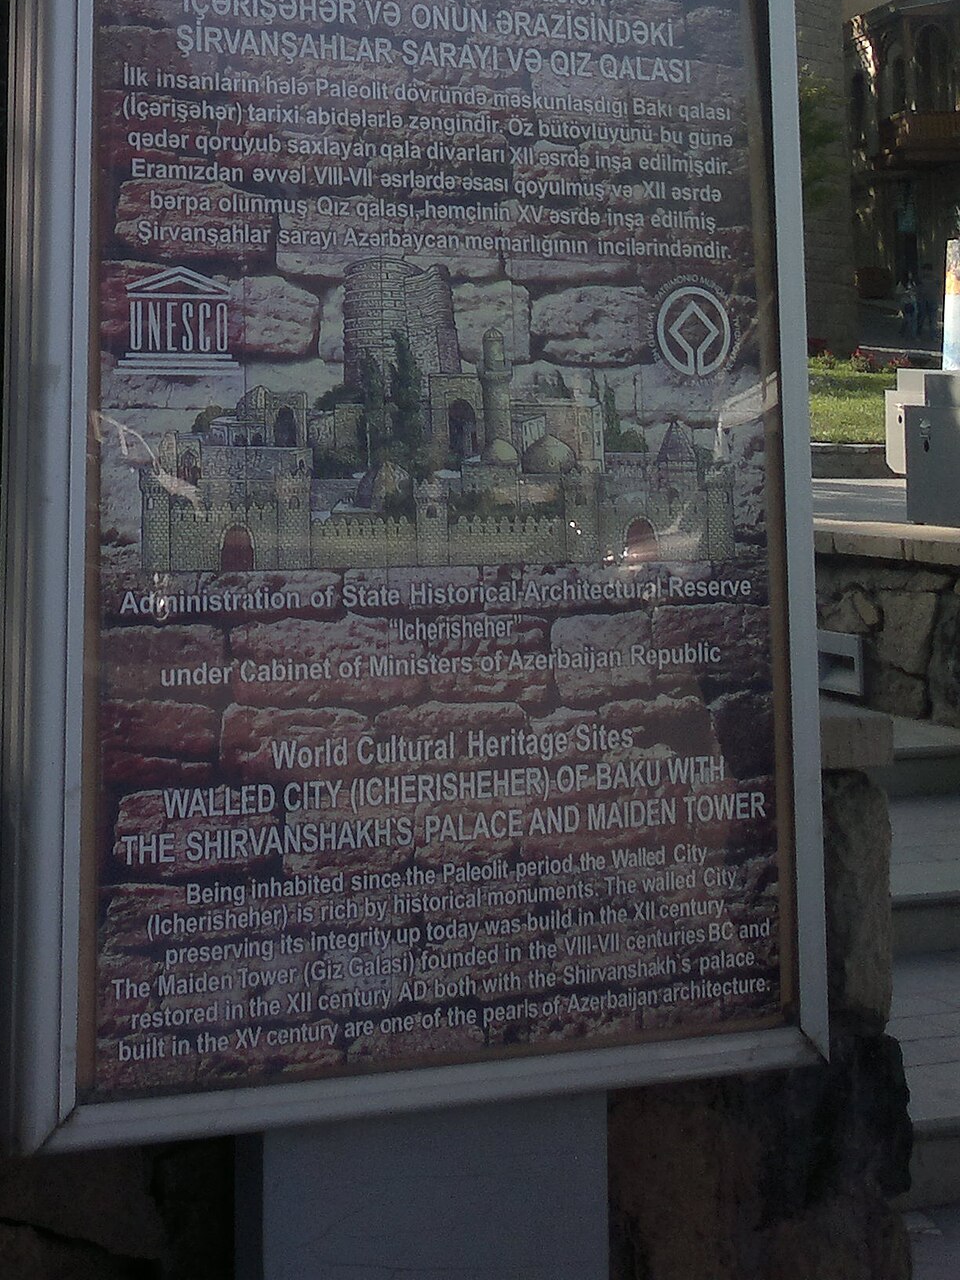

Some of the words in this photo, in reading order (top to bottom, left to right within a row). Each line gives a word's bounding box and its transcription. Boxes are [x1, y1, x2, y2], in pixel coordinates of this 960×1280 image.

[176, 20, 393, 66] ŞİRVANŞAHLAR
[402, 39, 498, 70] SARAYI
[506, 49, 541, 73] VƏ
[550, 50, 592, 77] QIZ
[599, 53, 691, 83] QALASI
[364, 0, 401, 27] VƏ
[411, 3, 487, 33] ONUN
[495, 10, 674, 48] ƏRAZİSİNDƏKİ
[122, 93, 241, 125] (İçərişəhər)
[248, 104, 299, 122] tarixi
[306, 105, 402, 129] abidələrlə
[409, 114, 504, 136] zəngindir.
[508, 114, 534, 137] Öz
[539, 119, 653, 144] bütövlüyünü
[660, 127, 683, 144] bu
[689, 127, 733, 149] günə
[123, 62, 148, 87] İlk
[156, 68, 259, 93] insanların
[265, 76, 308, 96] hələ
[315, 78, 389, 100] Paleolit
[394, 83, 487, 106] dövründə
[494, 91, 628, 119] məskunlaşdığı
[633, 98, 672, 117] Bakı
[678, 102, 731, 121] qalası
[138, 220, 271, 246] Şirvanşahlar
[278, 230, 338, 249] sarayı
[344, 227, 460, 252] Azərbaycan
[464, 233, 588, 257] memarlığının
[598, 237, 732, 260] incilərindəndir.
[149, 190, 211, 215] bərpa
[218, 192, 308, 218] olunmuş
[317, 195, 350, 215] Qız
[356, 199, 421, 221] qalası,
[425, 200, 510, 224] həmçinin
[517, 204, 543, 223] XV
[549, 206, 600, 225] əsrdə
[606, 208, 644, 230] inşa
[651, 210, 716, 234] edilmiş
[130, 301, 228, 351] UNESCO
[119, 586, 301, 614] Administration
[310, 585, 335, 607] of
[342, 583, 400, 607] State
[669, 576, 751, 597] Reserve
[160, 660, 232, 687] under
[241, 658, 331, 683] Cabinet
[339, 656, 362, 678] of
[369, 652, 472, 676] Ministers
[481, 650, 504, 672] of
[509, 648, 621, 673] Azerbaijan
[630, 643, 721, 670] Republic
[272, 738, 348, 770] World
[356, 731, 454, 765] Cultural
[468, 729, 567, 760] Heritage
[575, 723, 634, 751] Sites
[162, 785, 275, 819] WALLED
[283, 778, 342, 811] CITY
[350, 767, 550, 813] (ICHERISHEHER)
[556, 764, 589, 793] OF
[597, 760, 660, 791] BAKU
[667, 755, 724, 784] WITH
[121, 832, 176, 865] THE
[425, 808, 523, 844] PALACE
[529, 804, 579, 836] AND
[588, 797, 676, 831] MAIDEN
[683, 791, 766, 824] TOWER
[147, 904, 288, 940] (Icherisheher)
[297, 903, 314, 923] is
[321, 899, 358, 920] rich
[365, 898, 388, 918] by
[394, 888, 481, 914] historical
[488, 882, 599, 906] monuments.
[604, 876, 637, 896] The
[642, 871, 696, 892] walled
[703, 867, 738, 889] City
[187, 882, 245, 905] Being
[251, 872, 344, 899] inhabited
[351, 873, 402, 892] since
[406, 867, 436, 886] the
[443, 859, 509, 883] Paleolit
[516, 852, 573, 881] period
[579, 852, 606, 870] the
[611, 845, 665, 868] Walled
[673, 844, 708, 866] City
[112, 979, 150, 1000] The
[158, 973, 233, 997] Maiden
[238, 967, 297, 989] Tower
[303, 960, 344, 986] (Giz
[349, 952, 414, 977] Galasi)
[421, 945, 499, 970] founded
[505, 942, 521, 963] in
[528, 940, 557, 960] the
[564, 933, 620, 956] VIII-VII
[626, 927, 705, 949] centuries
[709, 921, 733, 942] BC
[739, 918, 770, 938] and
[165, 937, 273, 969] preserving
[280, 935, 304, 954] its
[311, 927, 391, 953] integrity
[397, 928, 420, 948] up
[426, 920, 479, 942] today
[485, 918, 521, 936] was
[528, 909, 572, 931] build
[578, 907, 594, 926] in
[600, 905, 627, 924] the
[634, 901, 655, 921] XII
[659, 899, 728, 920] century.
[119, 1040, 165, 1062] built
[172, 1035, 189, 1056] in
[197, 1032, 229, 1053] the
[235, 1026, 261, 1049] XV
[267, 1022, 338, 1046] century
[344, 1019, 374, 1039] are
[380, 1015, 413, 1033] one
[419, 1007, 442, 1029] of
[447, 1005, 477, 1026] the
[483, 999, 538, 1028] pearls
[542, 996, 561, 1017] of
[567, 986, 658, 1014] Azerbaijan
[664, 976, 771, 1003] architecture.
[130, 1001, 218, 1029] restored
[226, 1000, 243, 1020] in
[249, 997, 281, 1017] the
[286, 992, 312, 1014] XII
[318, 988, 391, 1011] century
[397, 980, 426, 1003] AD
[434, 976, 477, 998] both
[482, 972, 521, 994] with
[528, 969, 556, 988] the
[700, 950, 755, 974] palace
